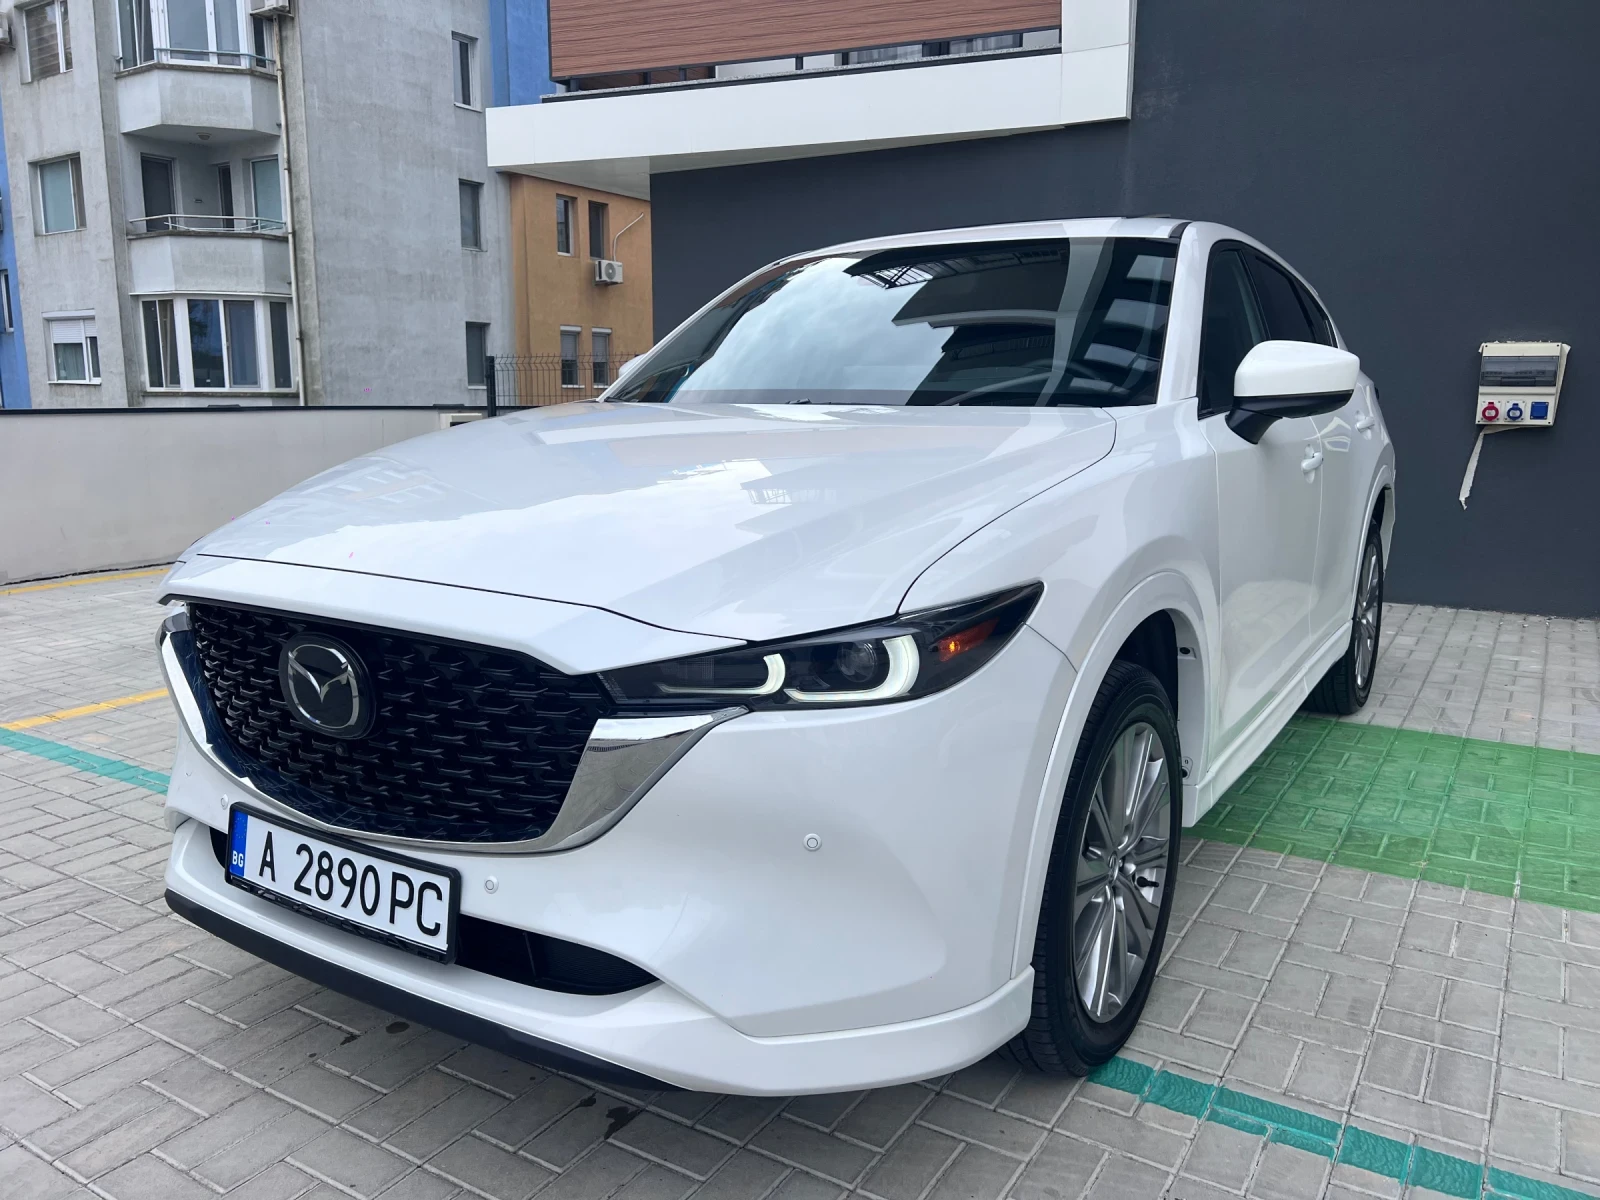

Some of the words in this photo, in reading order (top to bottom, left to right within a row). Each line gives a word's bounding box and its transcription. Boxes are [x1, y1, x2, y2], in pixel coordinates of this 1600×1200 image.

[232, 849, 244, 868] BG
[258, 830, 276, 882] A
[293, 843, 381, 917] 2890
[389, 871, 443, 937] PC
